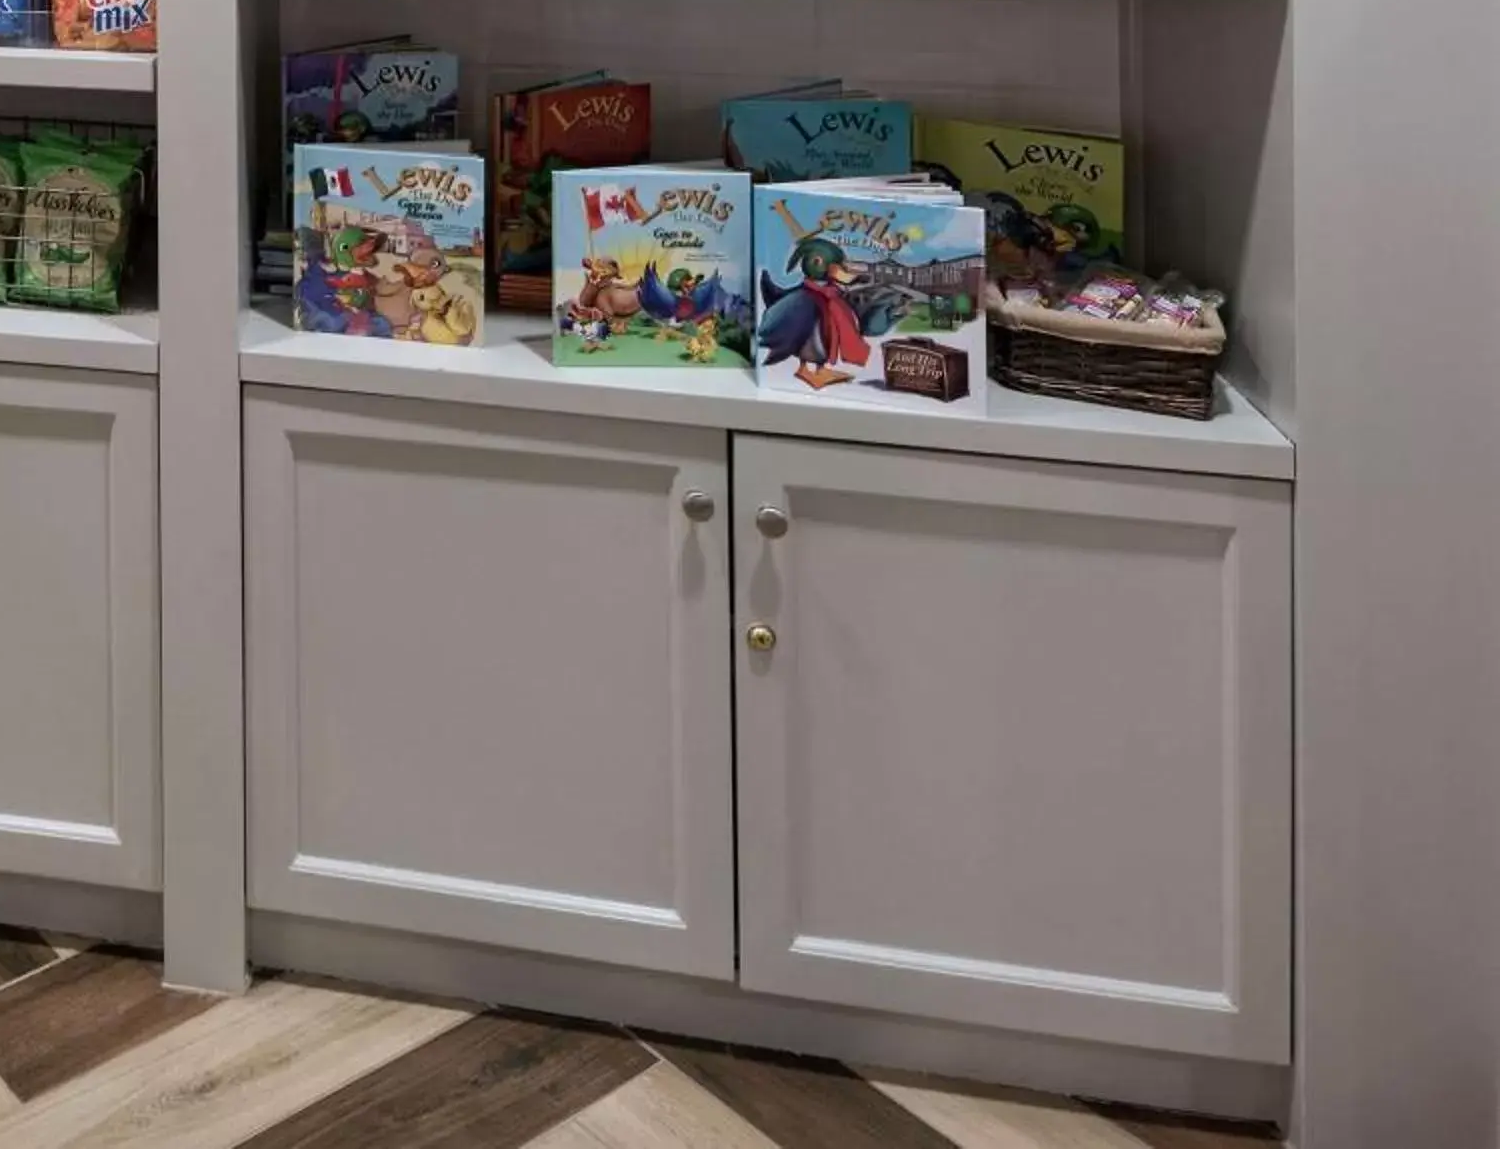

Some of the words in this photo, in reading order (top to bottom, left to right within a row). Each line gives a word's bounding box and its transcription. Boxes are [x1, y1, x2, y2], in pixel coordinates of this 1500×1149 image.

[350, 59, 442, 99] Lewis
[548, 92, 636, 132] Lewis
[785, 106, 895, 146] Lewis
[984, 137, 1105, 182] Lewis
[361, 164, 473, 202] Lewis
[624, 182, 735, 227] Lewis
[770, 198, 910, 252] Lewis
